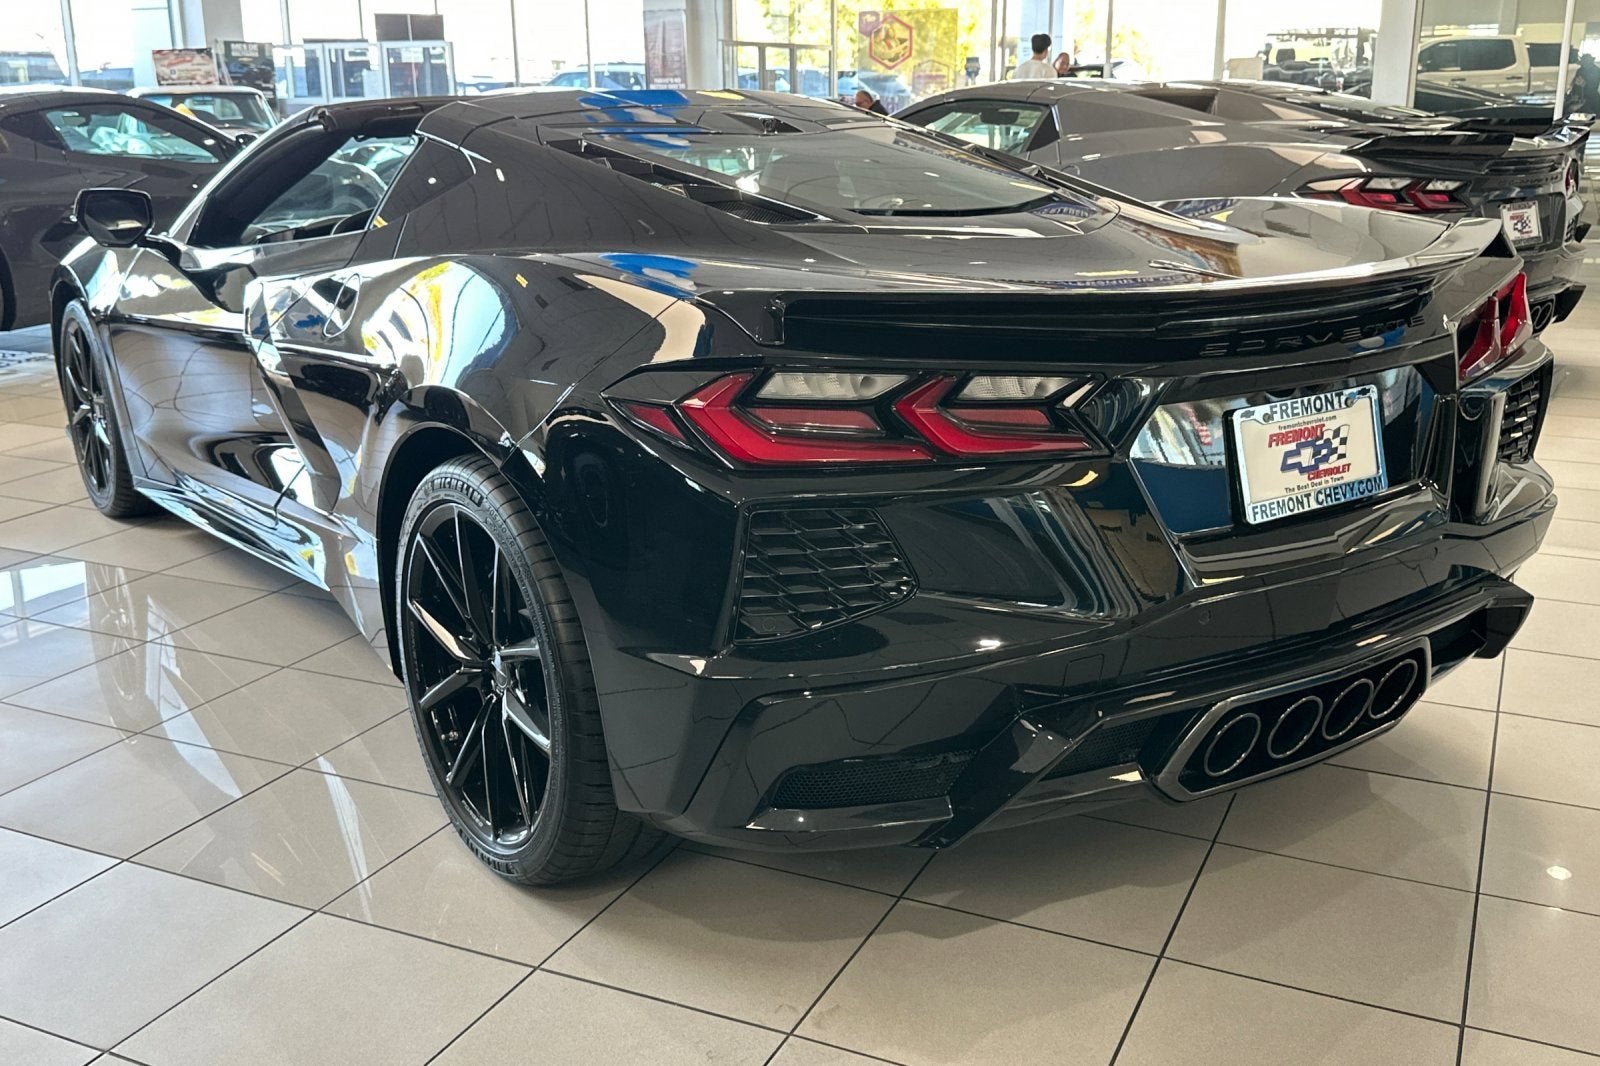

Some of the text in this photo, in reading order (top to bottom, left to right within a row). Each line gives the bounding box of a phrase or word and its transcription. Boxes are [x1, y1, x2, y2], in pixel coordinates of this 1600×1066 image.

[1269, 391, 1345, 422] FREMONT
[1278, 414, 1337, 431] fremontchevrolet.com
[1267, 423, 1326, 448] FREMONT
[1307, 463, 1352, 481] CHEVROLET
[433, 477, 483, 507] MICHELIN
[1297, 483, 1309, 491] Best
[1311, 480, 1322, 488] Deal
[1251, 477, 1383, 522] FREMONT CHEVY.COM
